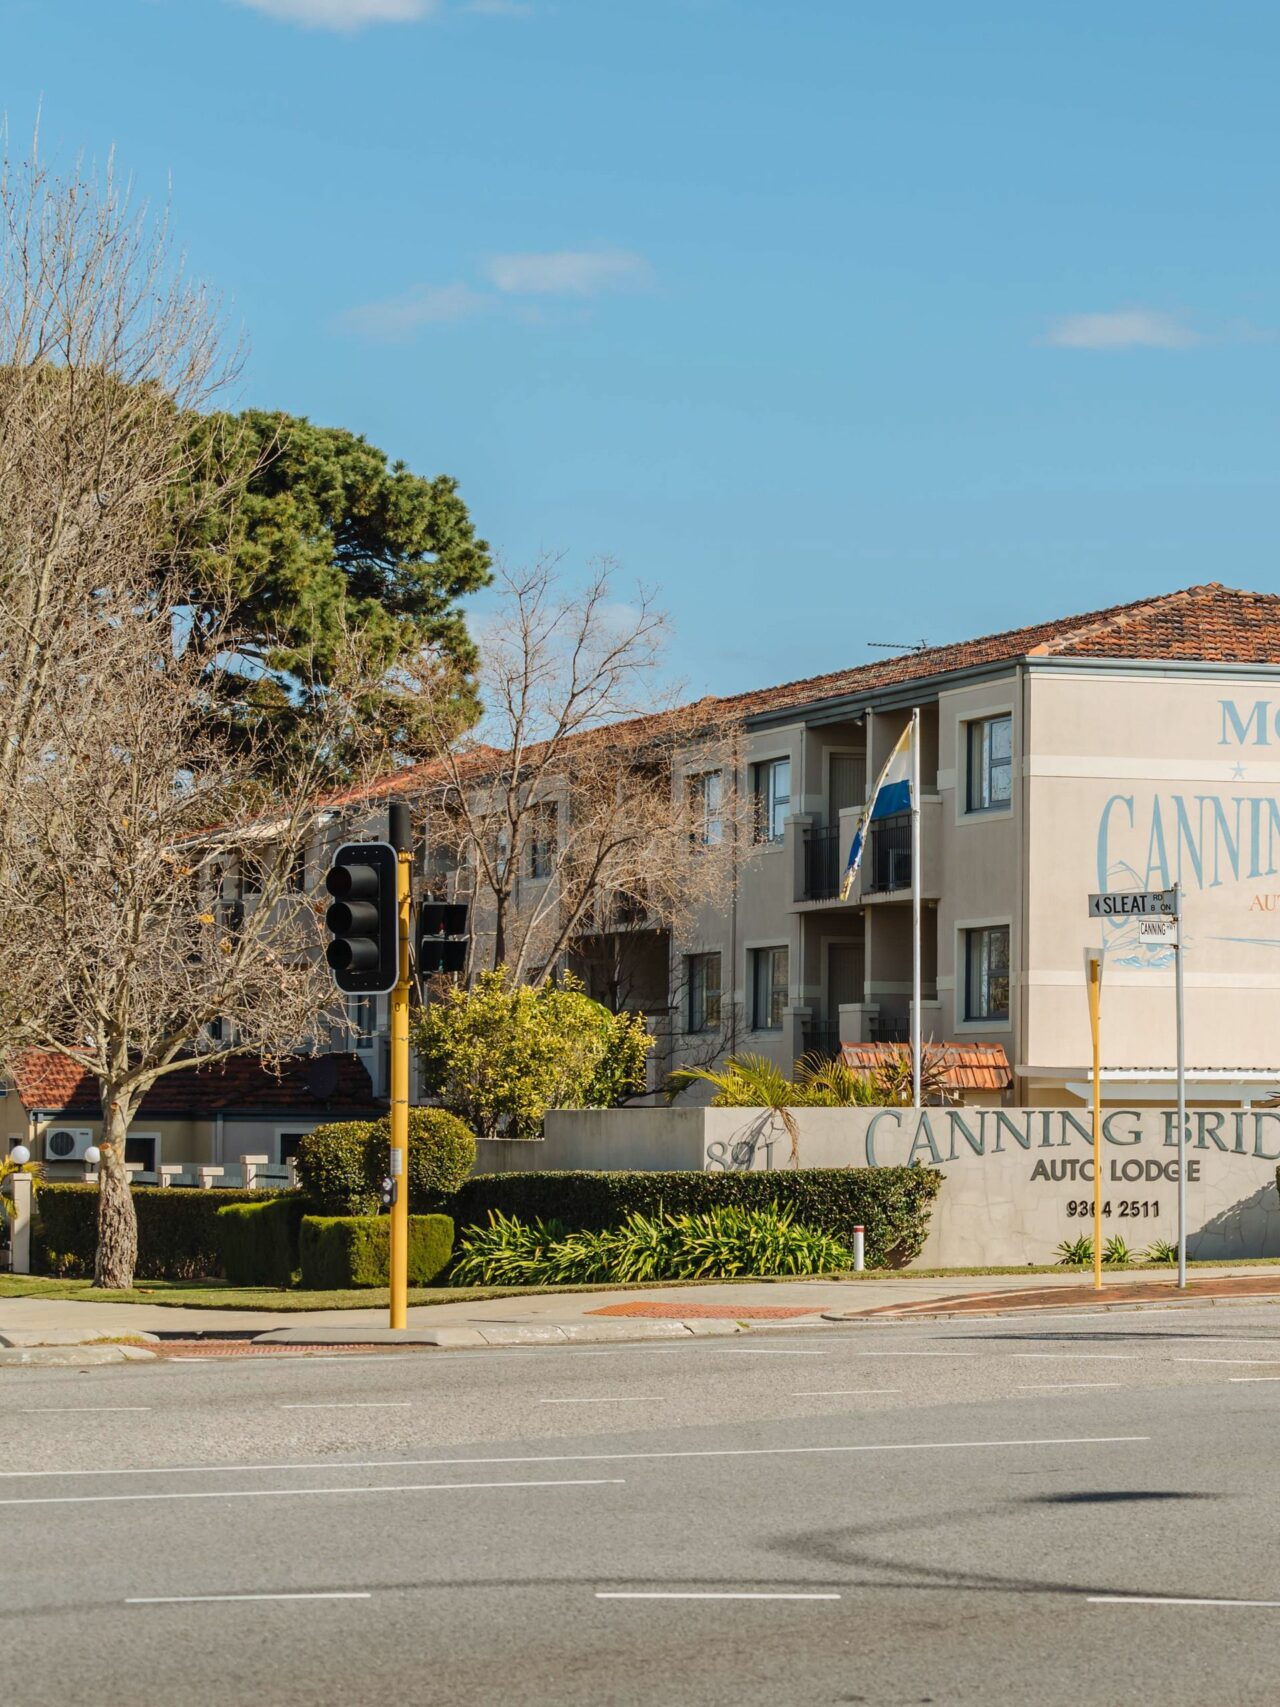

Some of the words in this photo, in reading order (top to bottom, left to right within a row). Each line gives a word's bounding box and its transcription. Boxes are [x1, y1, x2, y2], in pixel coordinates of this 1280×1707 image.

[1103, 896, 1147, 913] SLEAT
[1160, 903, 1172, 911] ON
[1140, 922, 1166, 935] CANNING
[865, 1109, 1144, 1168] CANNING
[705, 1140, 774, 1171] 891
[1030, 1159, 1102, 1182] AUTO
[1111, 1159, 1200, 1182] LODGE
[1117, 1200, 1160, 1218] 2511
